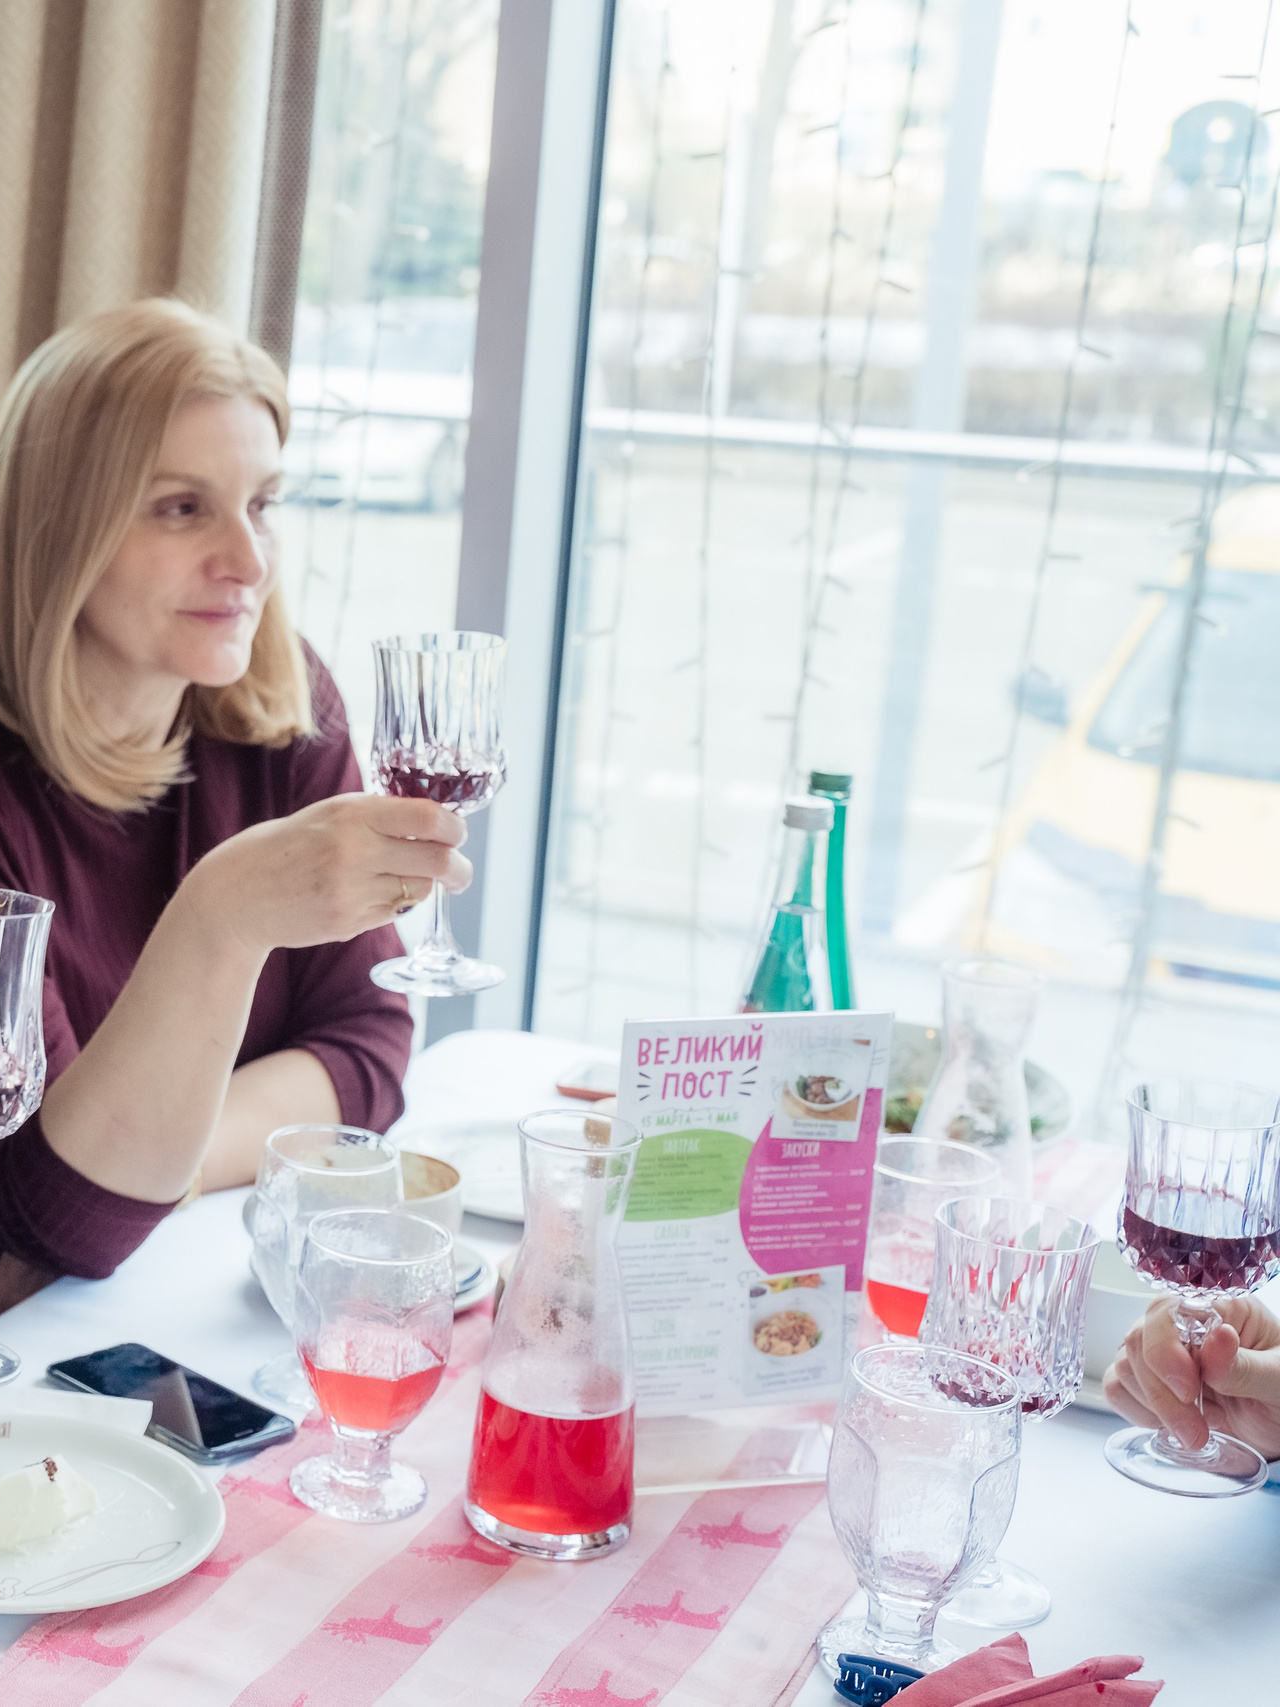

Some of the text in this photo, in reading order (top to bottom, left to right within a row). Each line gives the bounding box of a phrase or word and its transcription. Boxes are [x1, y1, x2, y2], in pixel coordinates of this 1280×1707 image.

[638, 1023, 763, 1067] ВЕЛИКИЙ
[661, 1070, 733, 1100] ПОСТ
[656, 1110, 691, 1126] МАРТА
[716, 1111, 739, 1123] МАЯ
[663, 1138, 700, 1155] ЗАВТРАК
[781, 1141, 820, 1159] ЗАКУСКИ
[654, 1224, 691, 1241] САЛАТЫ
